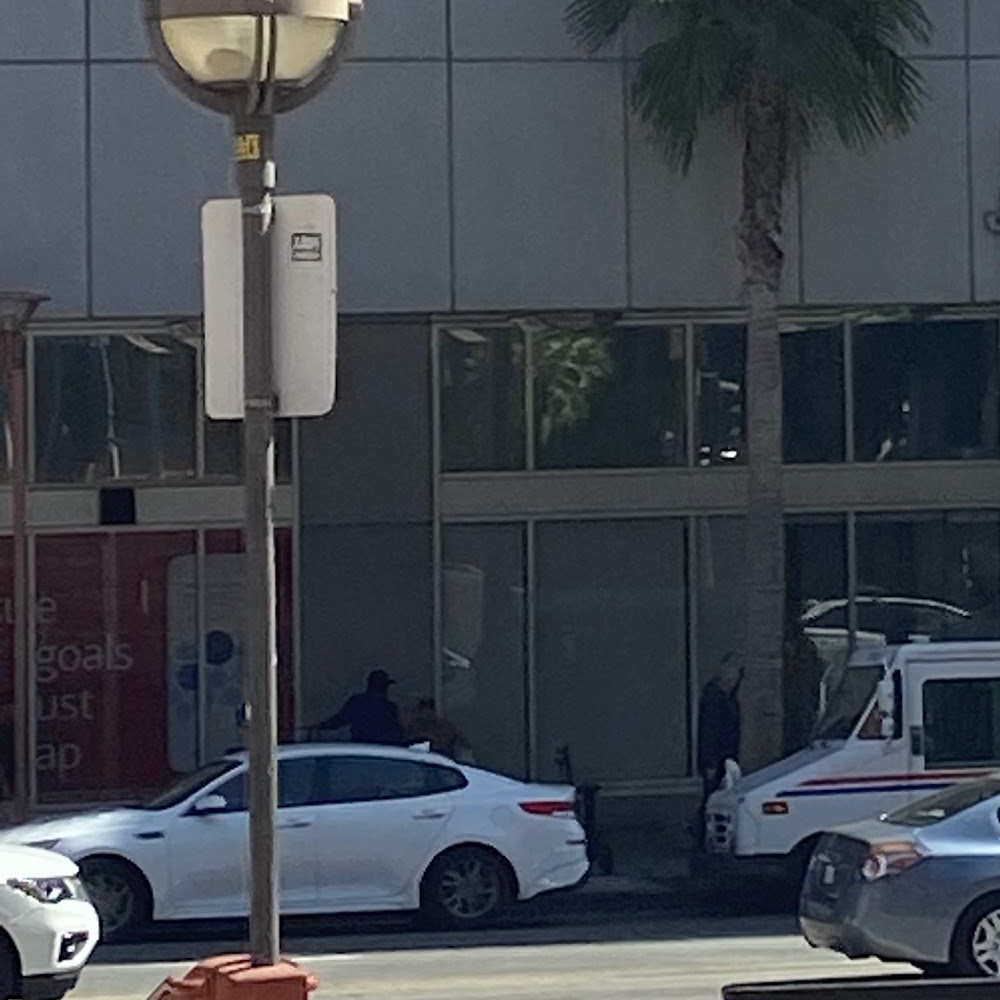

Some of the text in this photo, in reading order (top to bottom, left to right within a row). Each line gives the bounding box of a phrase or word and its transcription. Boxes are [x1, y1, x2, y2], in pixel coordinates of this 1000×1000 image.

[35, 632, 133, 683] goals
[36, 688, 95, 721] ust
[35, 742, 81, 777] ap
